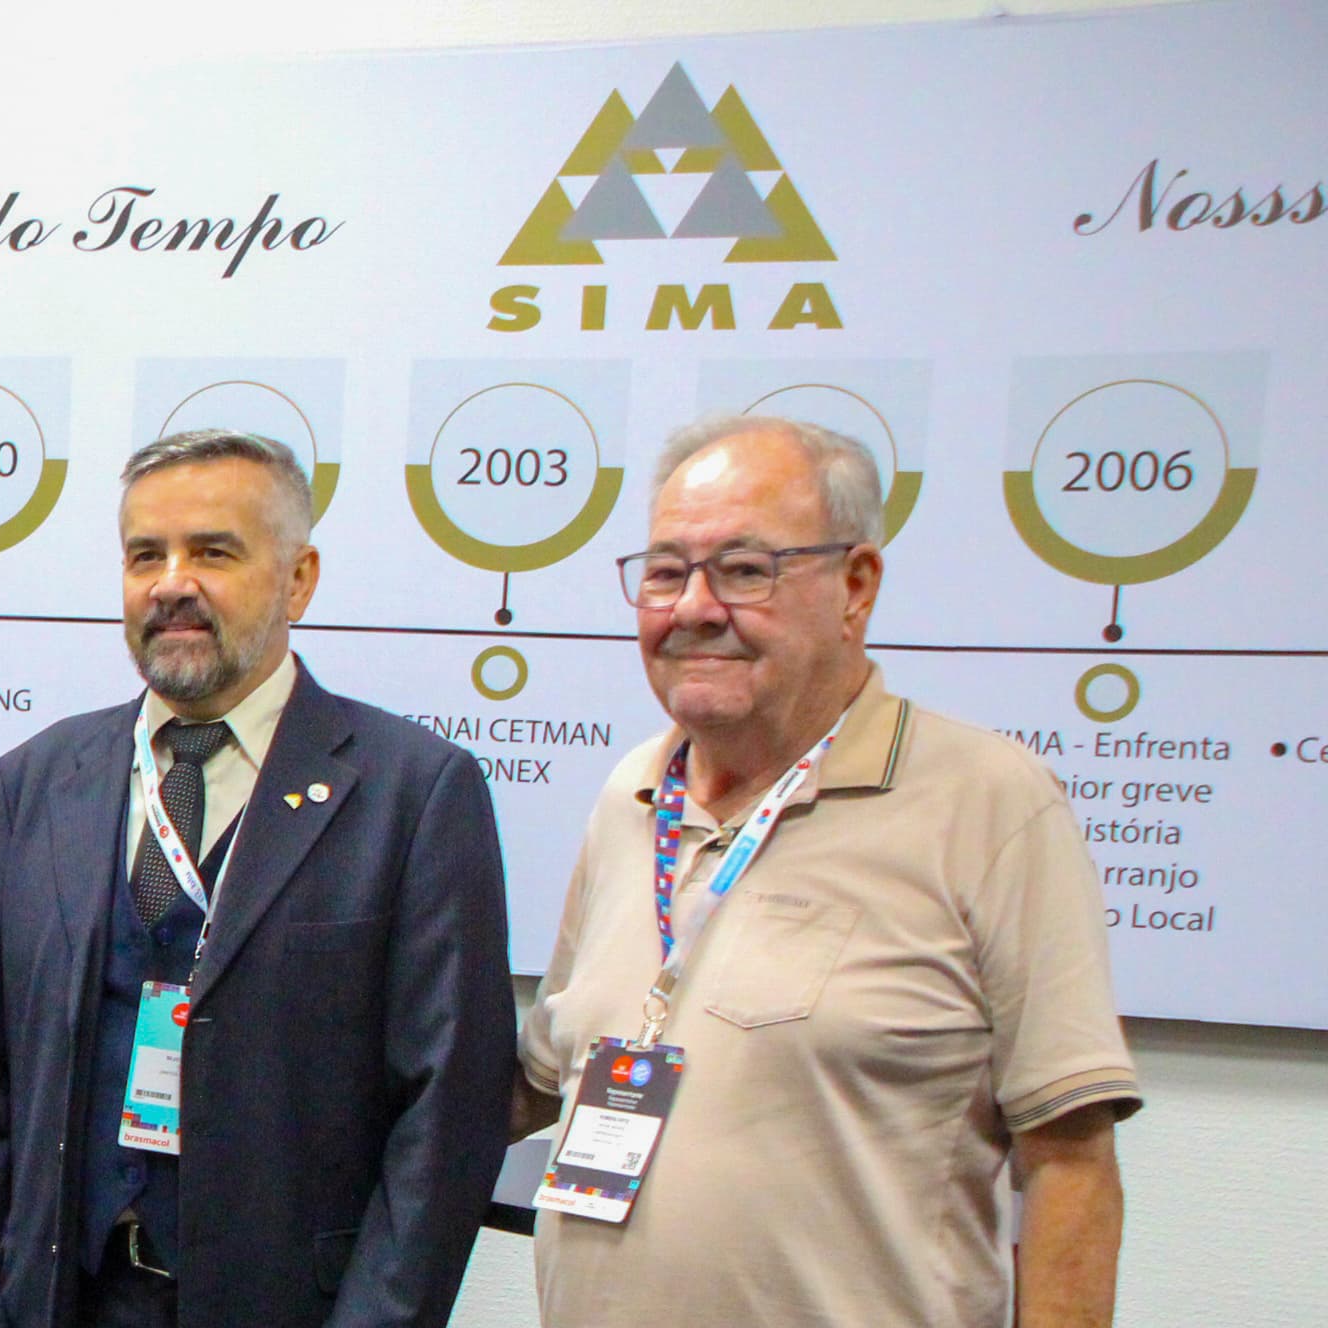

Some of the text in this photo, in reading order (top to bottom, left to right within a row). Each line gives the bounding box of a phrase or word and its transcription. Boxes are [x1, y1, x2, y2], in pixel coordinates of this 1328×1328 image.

[73, 185, 345, 279] Tempo
[487, 281, 844, 333] SIMA
[456, 447, 569, 487] 2003
[1061, 450, 1194, 492] 2006
[489, 718, 611, 747] CETMAN
[1094, 731, 1231, 761] Enfrenta
[476, 757, 551, 784] ONEX
[1122, 780, 1213, 808] greve
[1084, 816, 1182, 845] istória
[1103, 863, 1199, 894] rranjo
[1131, 903, 1215, 932] Local
